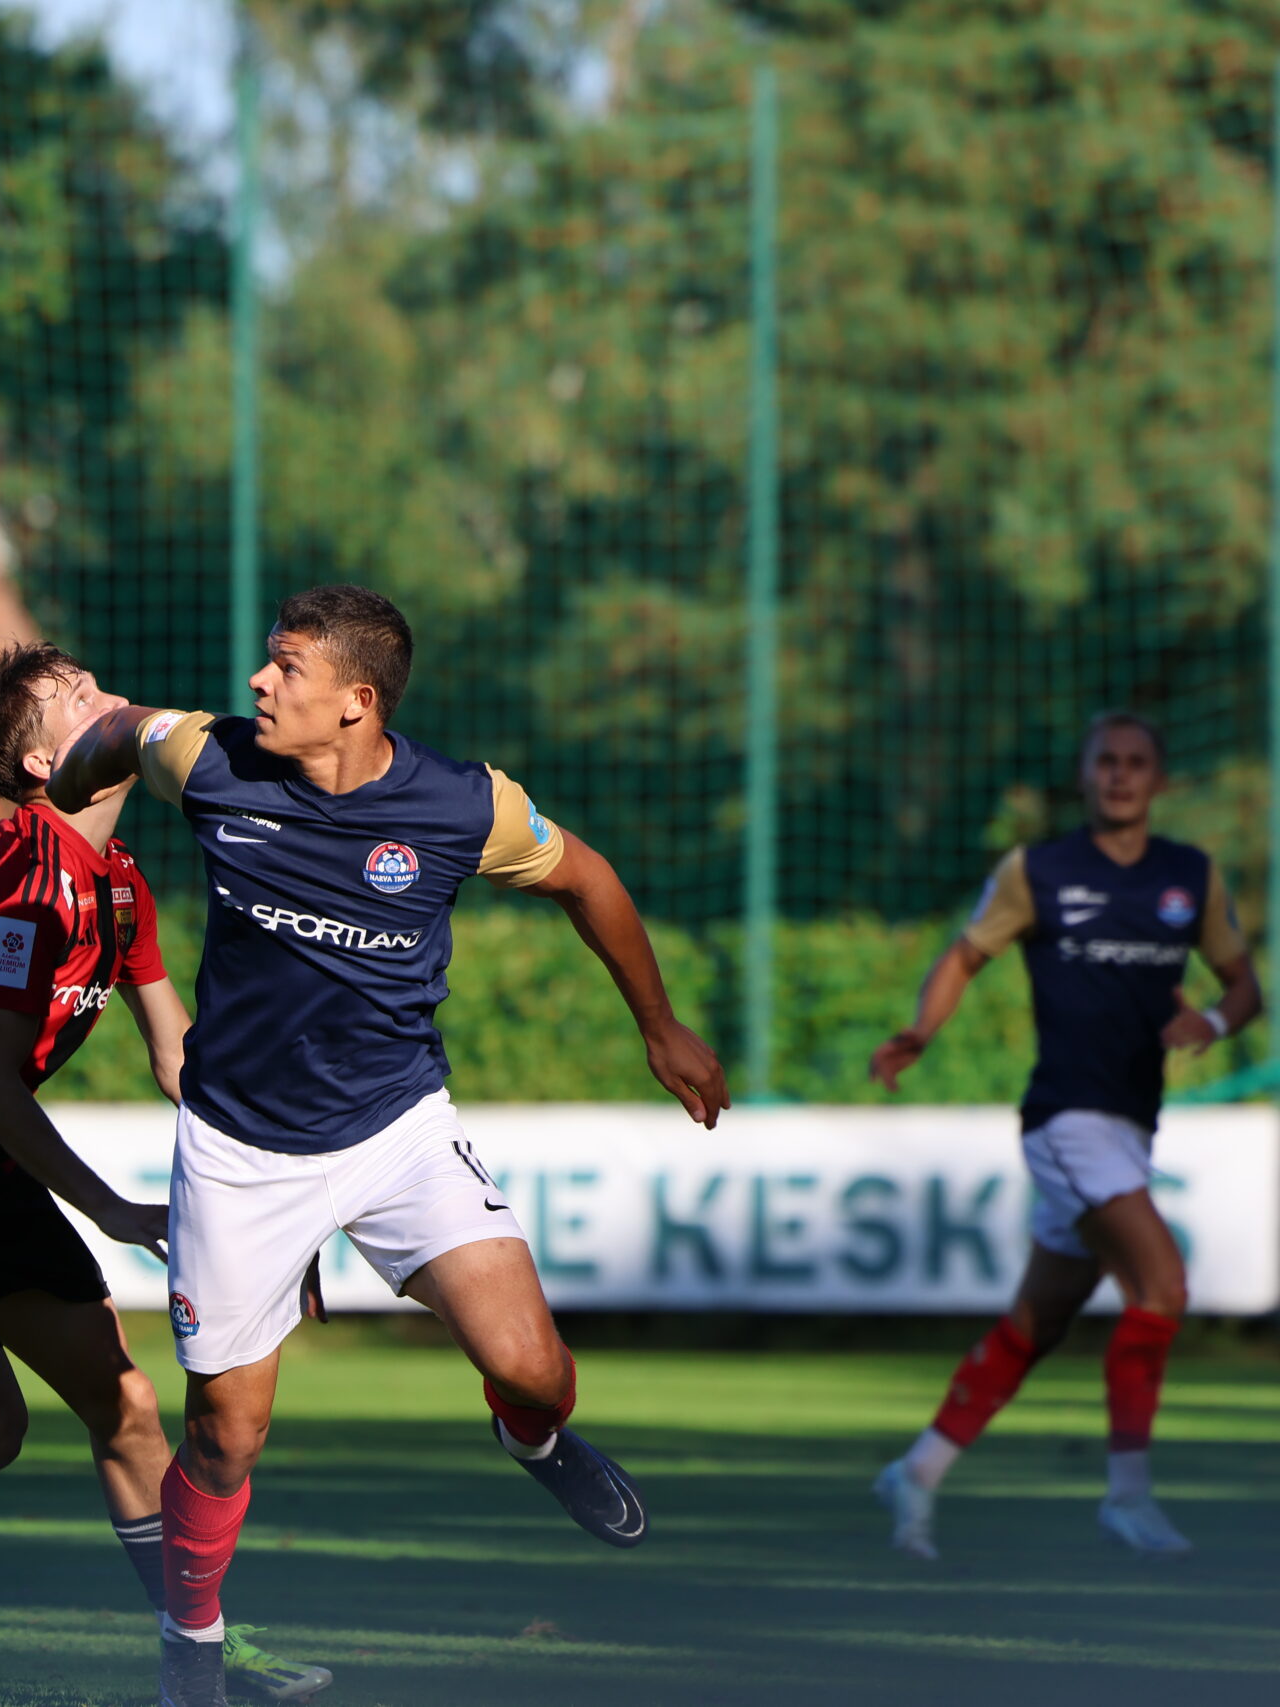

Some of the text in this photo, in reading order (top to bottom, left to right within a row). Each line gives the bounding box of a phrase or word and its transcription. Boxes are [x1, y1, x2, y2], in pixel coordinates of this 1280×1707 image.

[370, 873, 415, 883] NARVA TRANS
[647, 1168, 1195, 1285] KESKS
